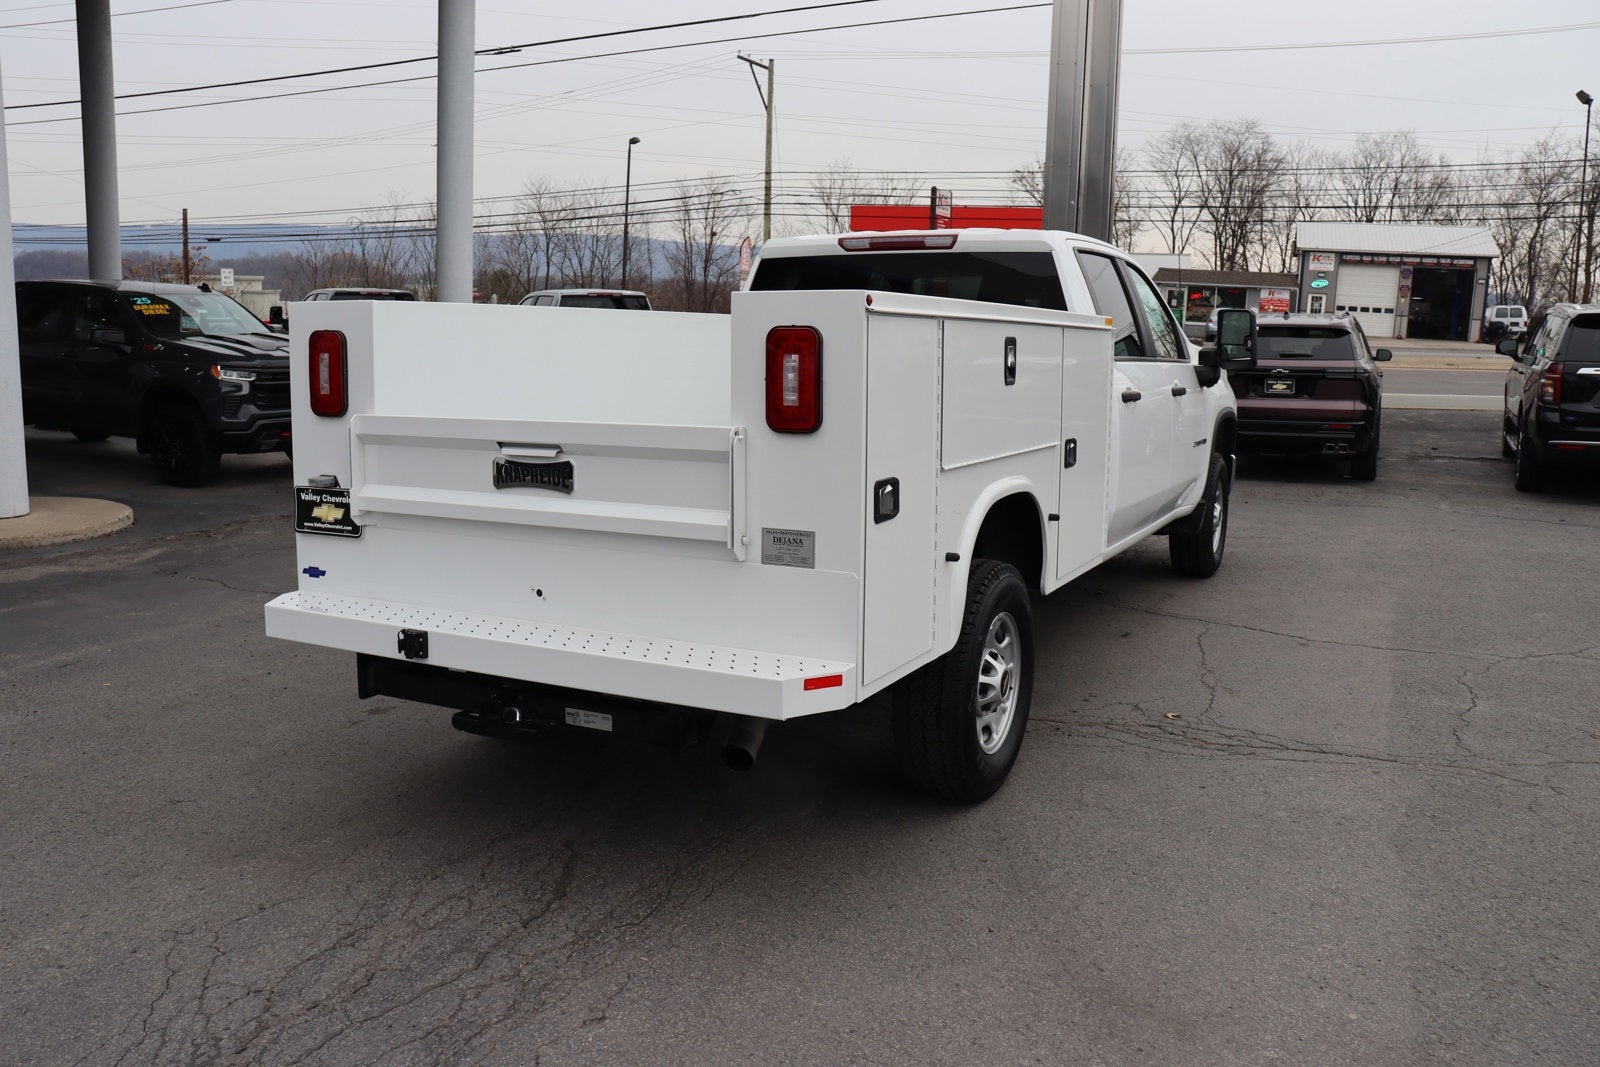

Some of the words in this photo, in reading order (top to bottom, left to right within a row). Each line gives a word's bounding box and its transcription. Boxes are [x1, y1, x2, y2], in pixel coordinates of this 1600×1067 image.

[495, 461, 571, 489] KNAPHEIDE
[300, 492, 320, 502] Valley
[773, 536, 804, 545] DEJANA
